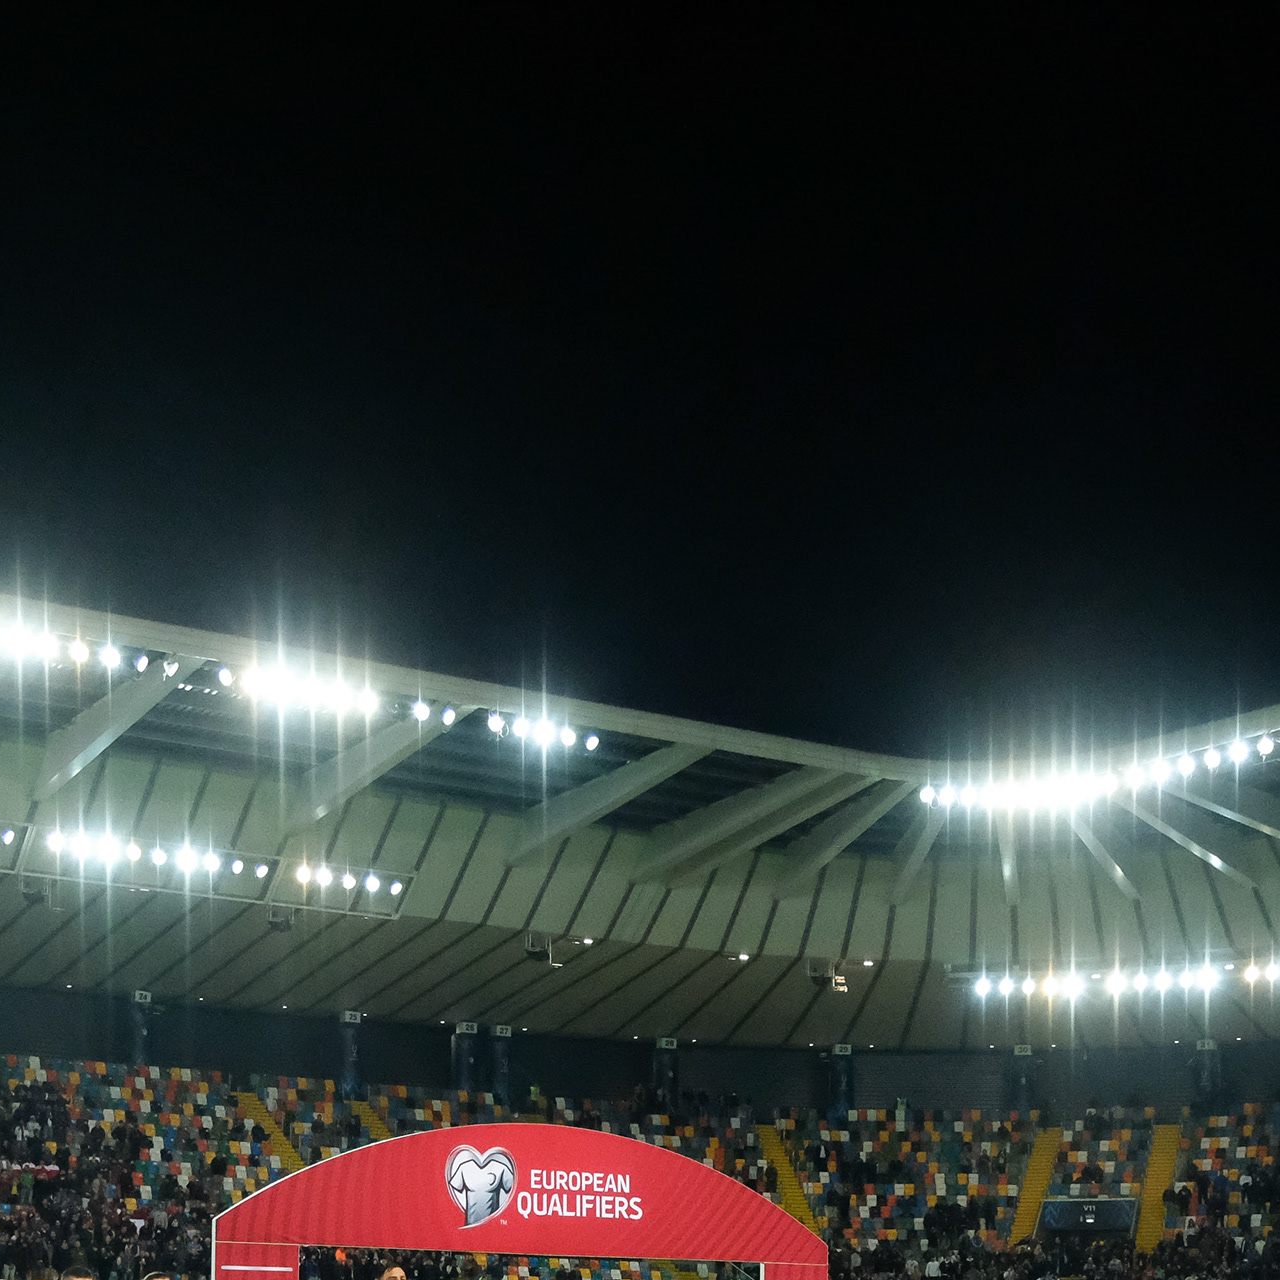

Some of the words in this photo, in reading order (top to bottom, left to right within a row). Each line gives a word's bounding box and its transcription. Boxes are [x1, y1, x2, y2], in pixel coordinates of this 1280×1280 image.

[138, 992, 148, 1001] 24
[499, 1027, 509, 1035] 27
[530, 1169, 630, 1193] EUROPEAN
[517, 1191, 643, 1220] QUALIFIERS
